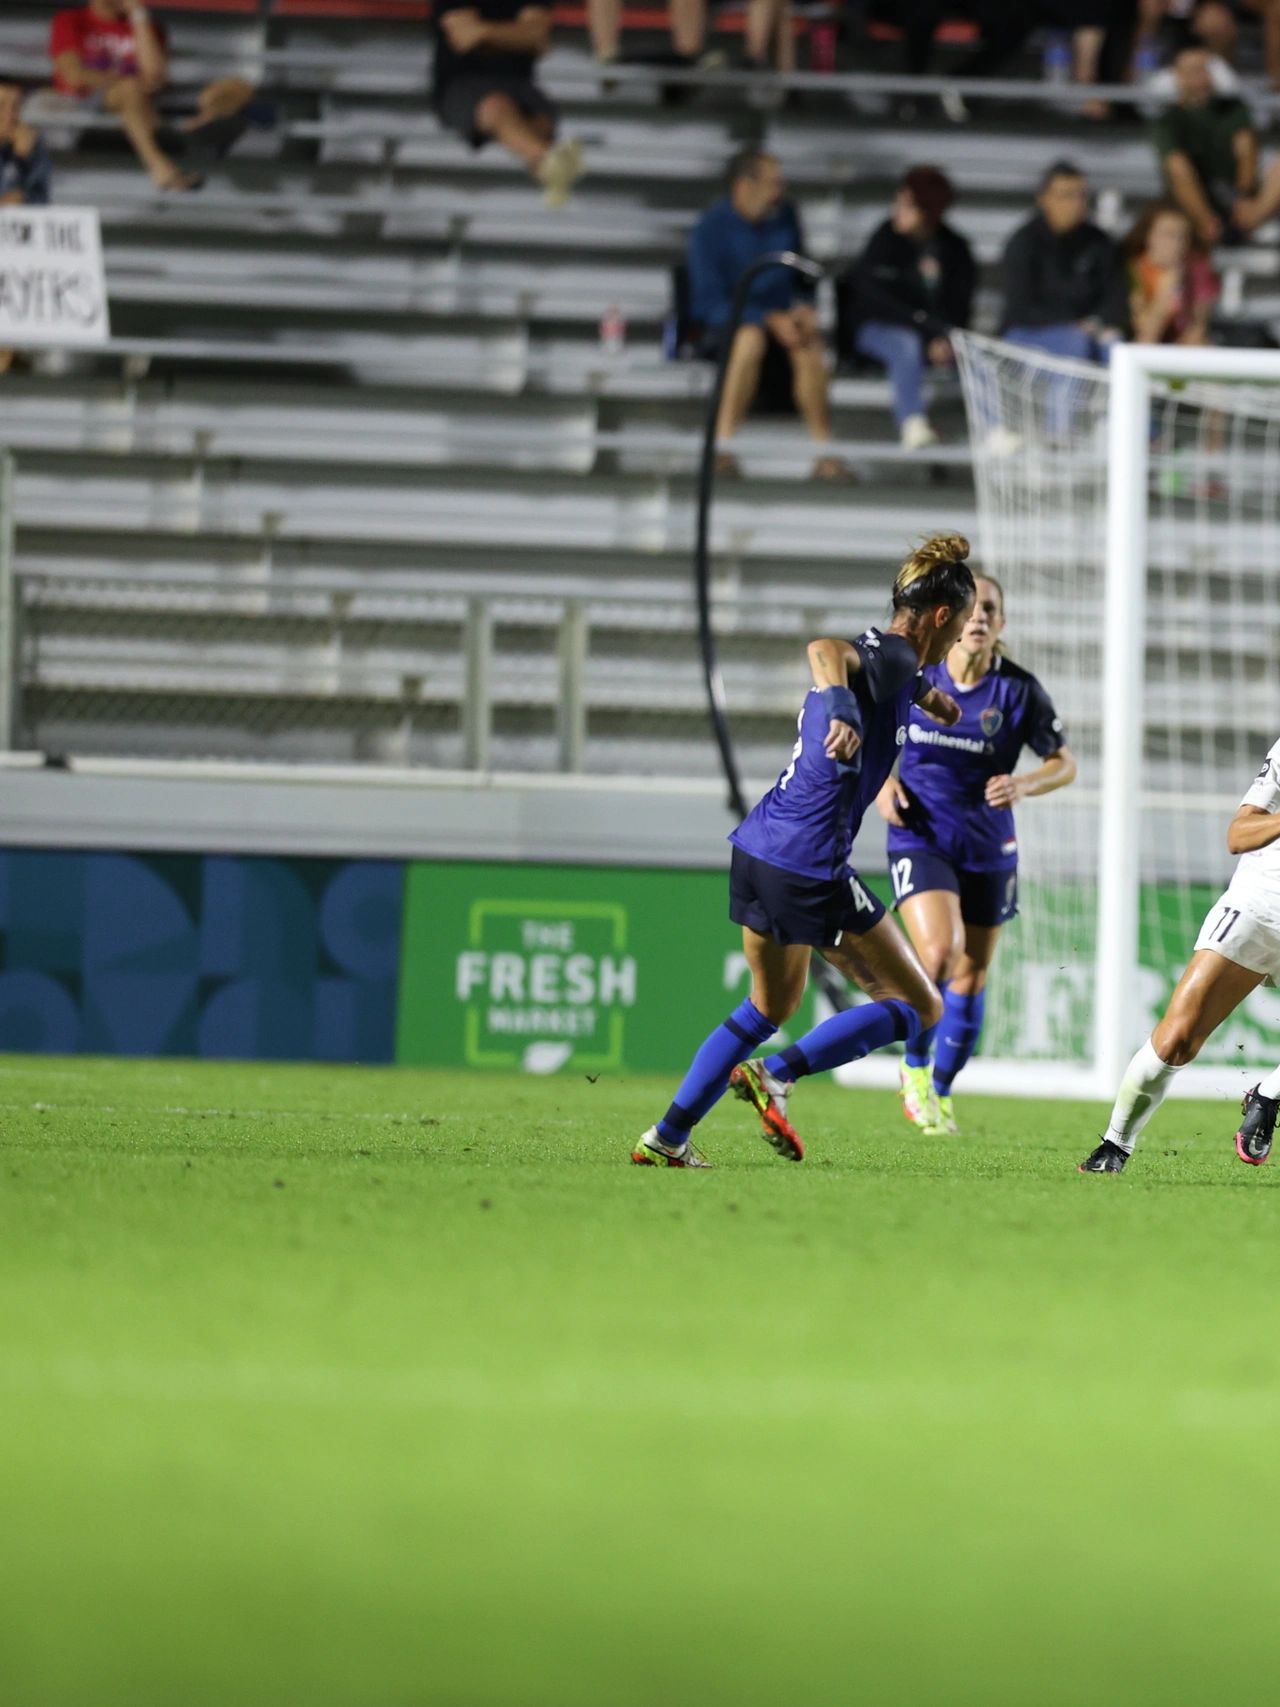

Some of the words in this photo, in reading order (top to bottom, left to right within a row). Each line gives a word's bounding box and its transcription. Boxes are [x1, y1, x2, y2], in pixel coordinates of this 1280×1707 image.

[849, 873, 876, 914] 4
[891, 857, 914, 900] 12
[522, 919, 574, 950] THE
[1208, 906, 1241, 943] 11
[456, 951, 637, 1006] FRESH
[488, 1006, 597, 1037] MARKET
